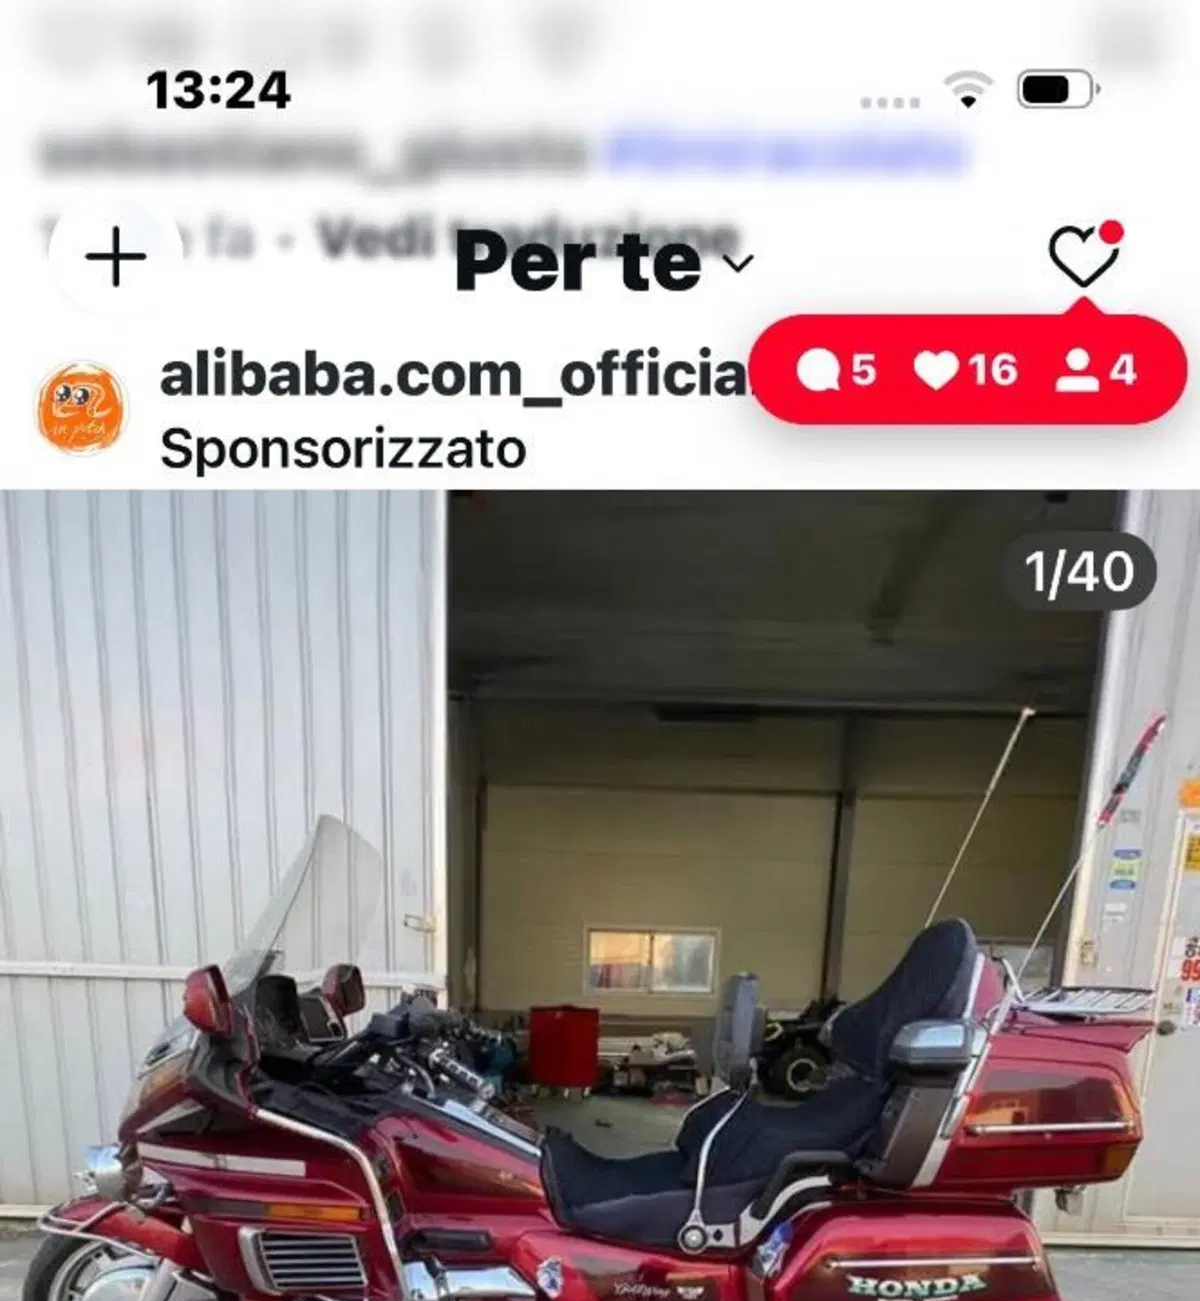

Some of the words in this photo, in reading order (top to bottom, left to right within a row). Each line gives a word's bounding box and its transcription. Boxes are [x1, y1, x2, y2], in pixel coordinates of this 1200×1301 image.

[147, 71, 291, 109] 13:24
[457, 230, 596, 292] Per
[616, 233, 701, 292] te
[160, 347, 754, 408] alibaba.com_officia
[853, 353, 877, 386] 5
[968, 353, 1018, 386] 16
[1109, 354, 1138, 386] 4
[161, 426, 526, 478] Sponsorizzato
[1025, 548, 1134, 601] 1/40
[846, 1273, 987, 1299] HONDA
